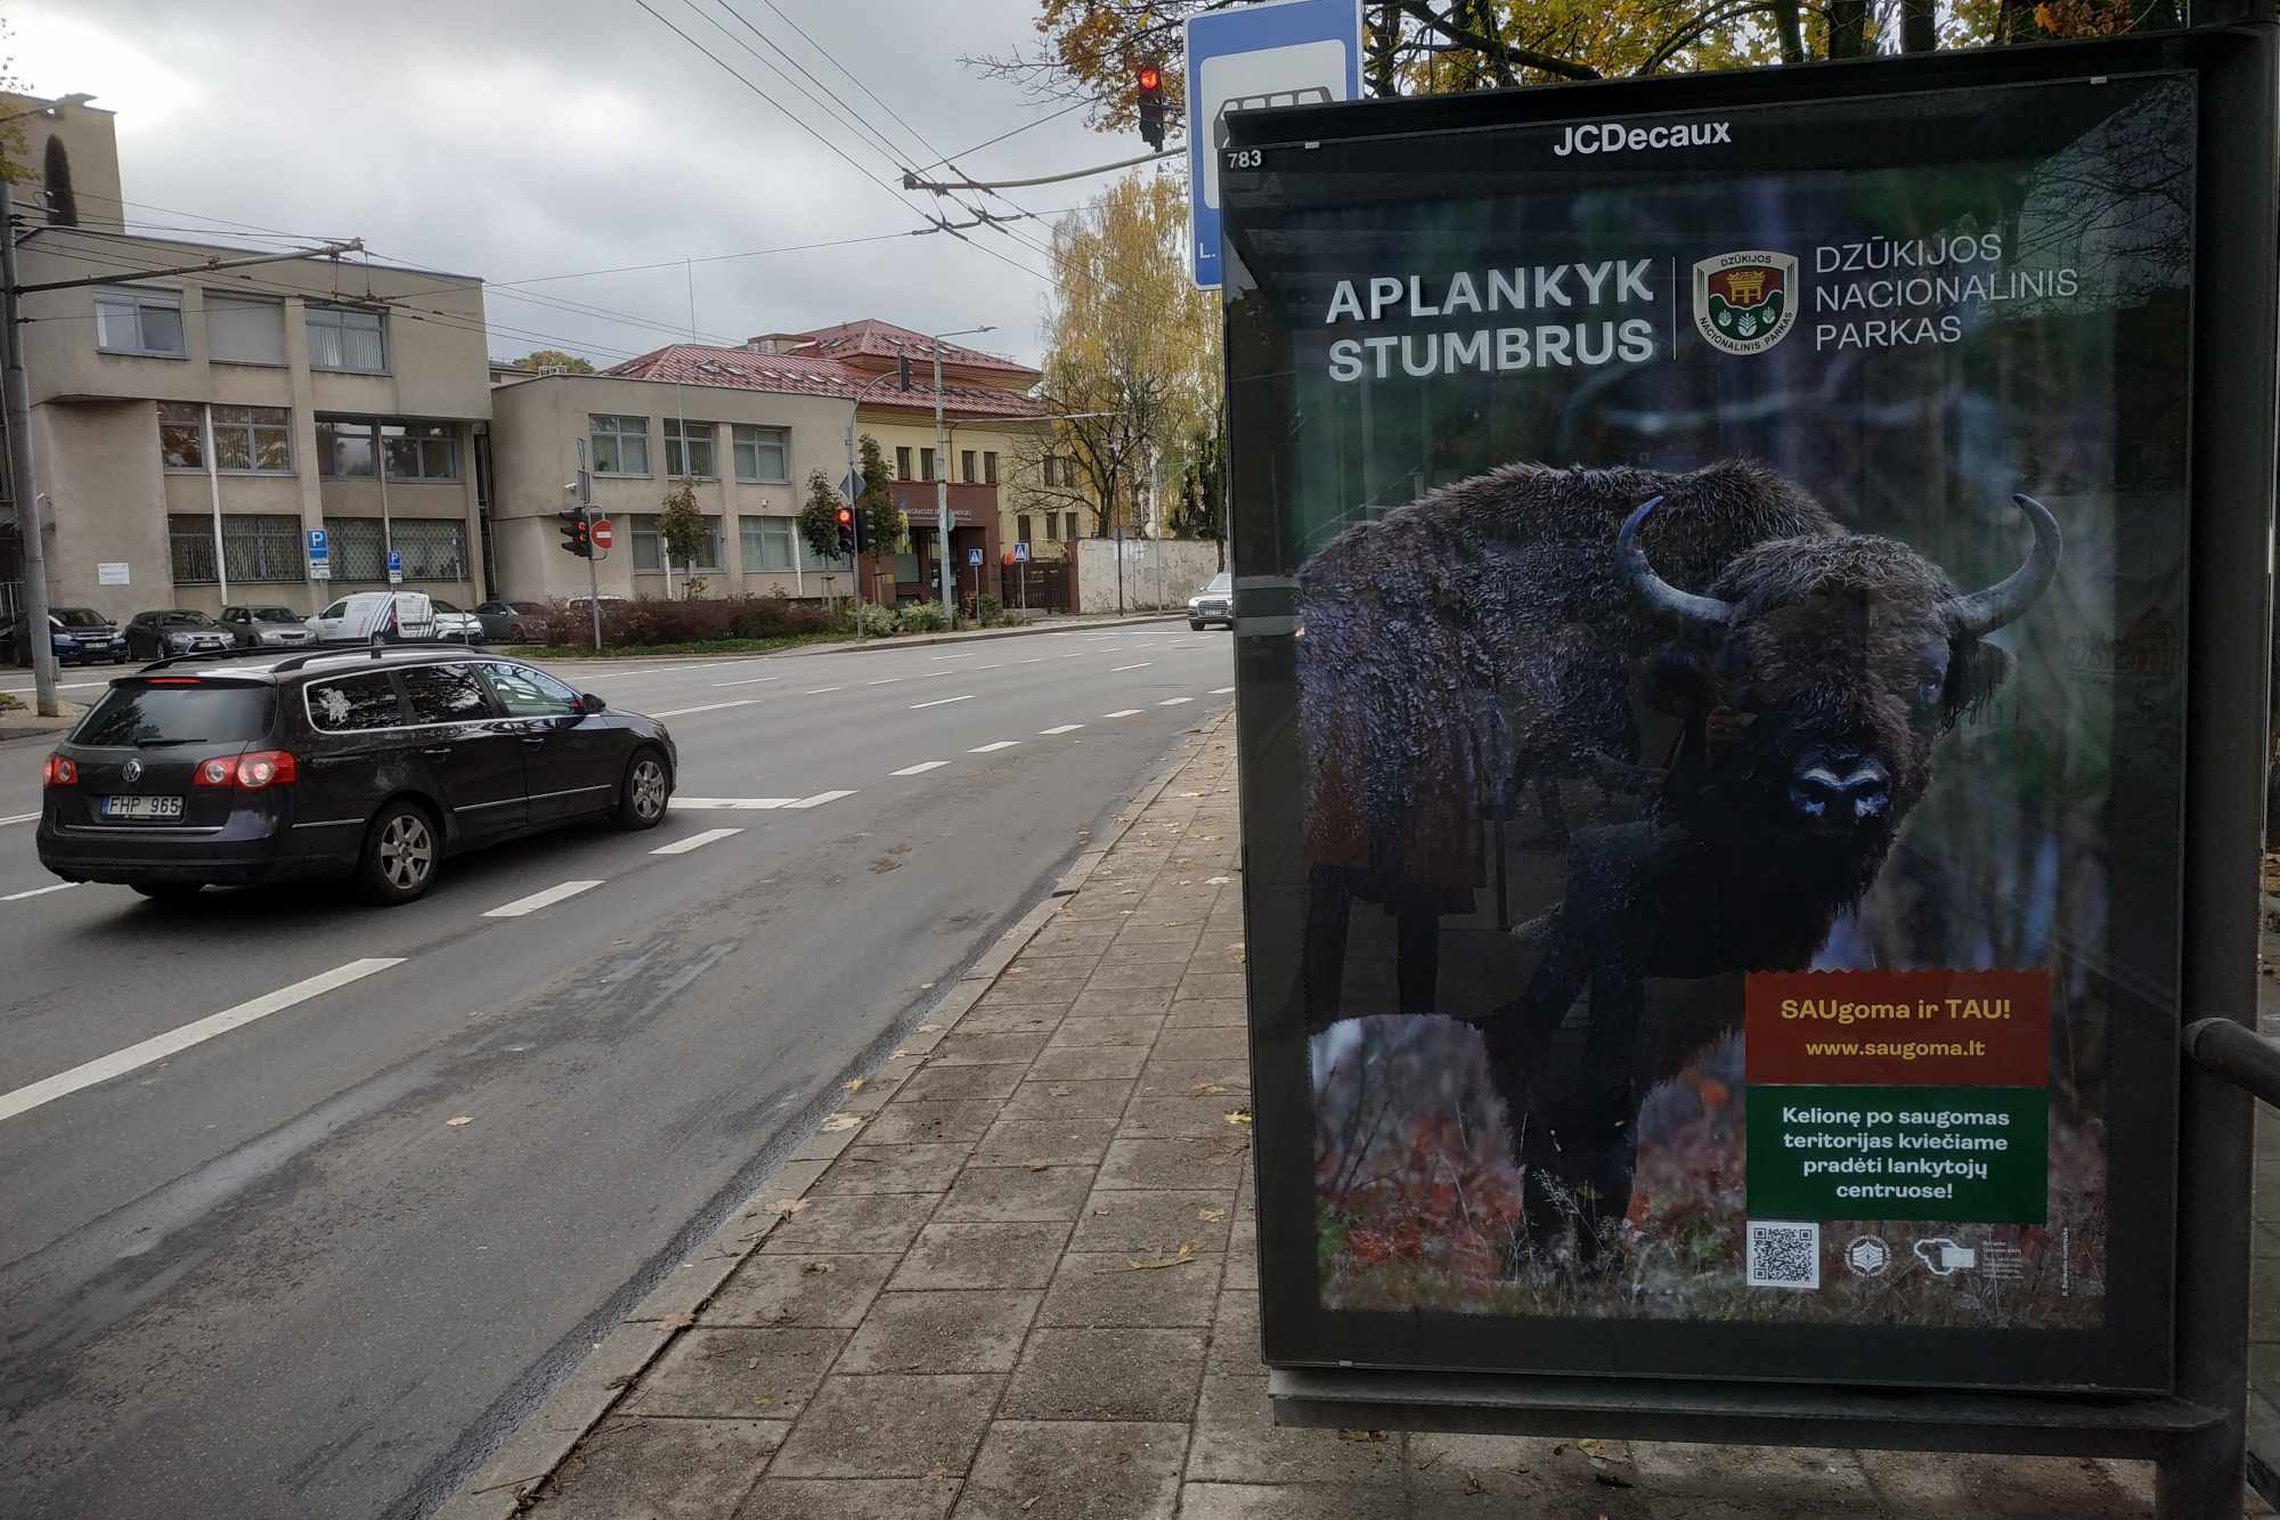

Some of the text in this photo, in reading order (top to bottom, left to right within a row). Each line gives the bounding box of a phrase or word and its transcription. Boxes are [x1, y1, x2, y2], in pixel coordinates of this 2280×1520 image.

[1553, 121, 1732, 157] JCDecaux
[1226, 149, 1262, 169] 783
[1199, 242, 1216, 259] L.
[1720, 254, 1772, 267] DZŪKIJOS
[1815, 233, 2003, 274] DZŪKIJOS
[1326, 257, 1655, 324] APLANKYK
[1815, 268, 2079, 313] NACIONALINIS
[1699, 310, 1793, 352] NACIONALINIS PARKAS
[1815, 315, 1963, 352] PARKAS
[1328, 319, 1654, 382] STUMBRUS
[312, 531, 323, 547] P
[109, 797, 178, 814] FHP 965
[1780, 998, 2012, 1025] SAUgoma ir TAU!
[1805, 1039, 1986, 1061] www.saugoma.lt
[1782, 1106, 2010, 1129] Kelionę po saugomas
[1783, 1132, 2009, 1154] teritorijas kviečiame
[1803, 1157, 1988, 1180] pradėti lankytojų
[1835, 1183, 1954, 1200] centruose!
